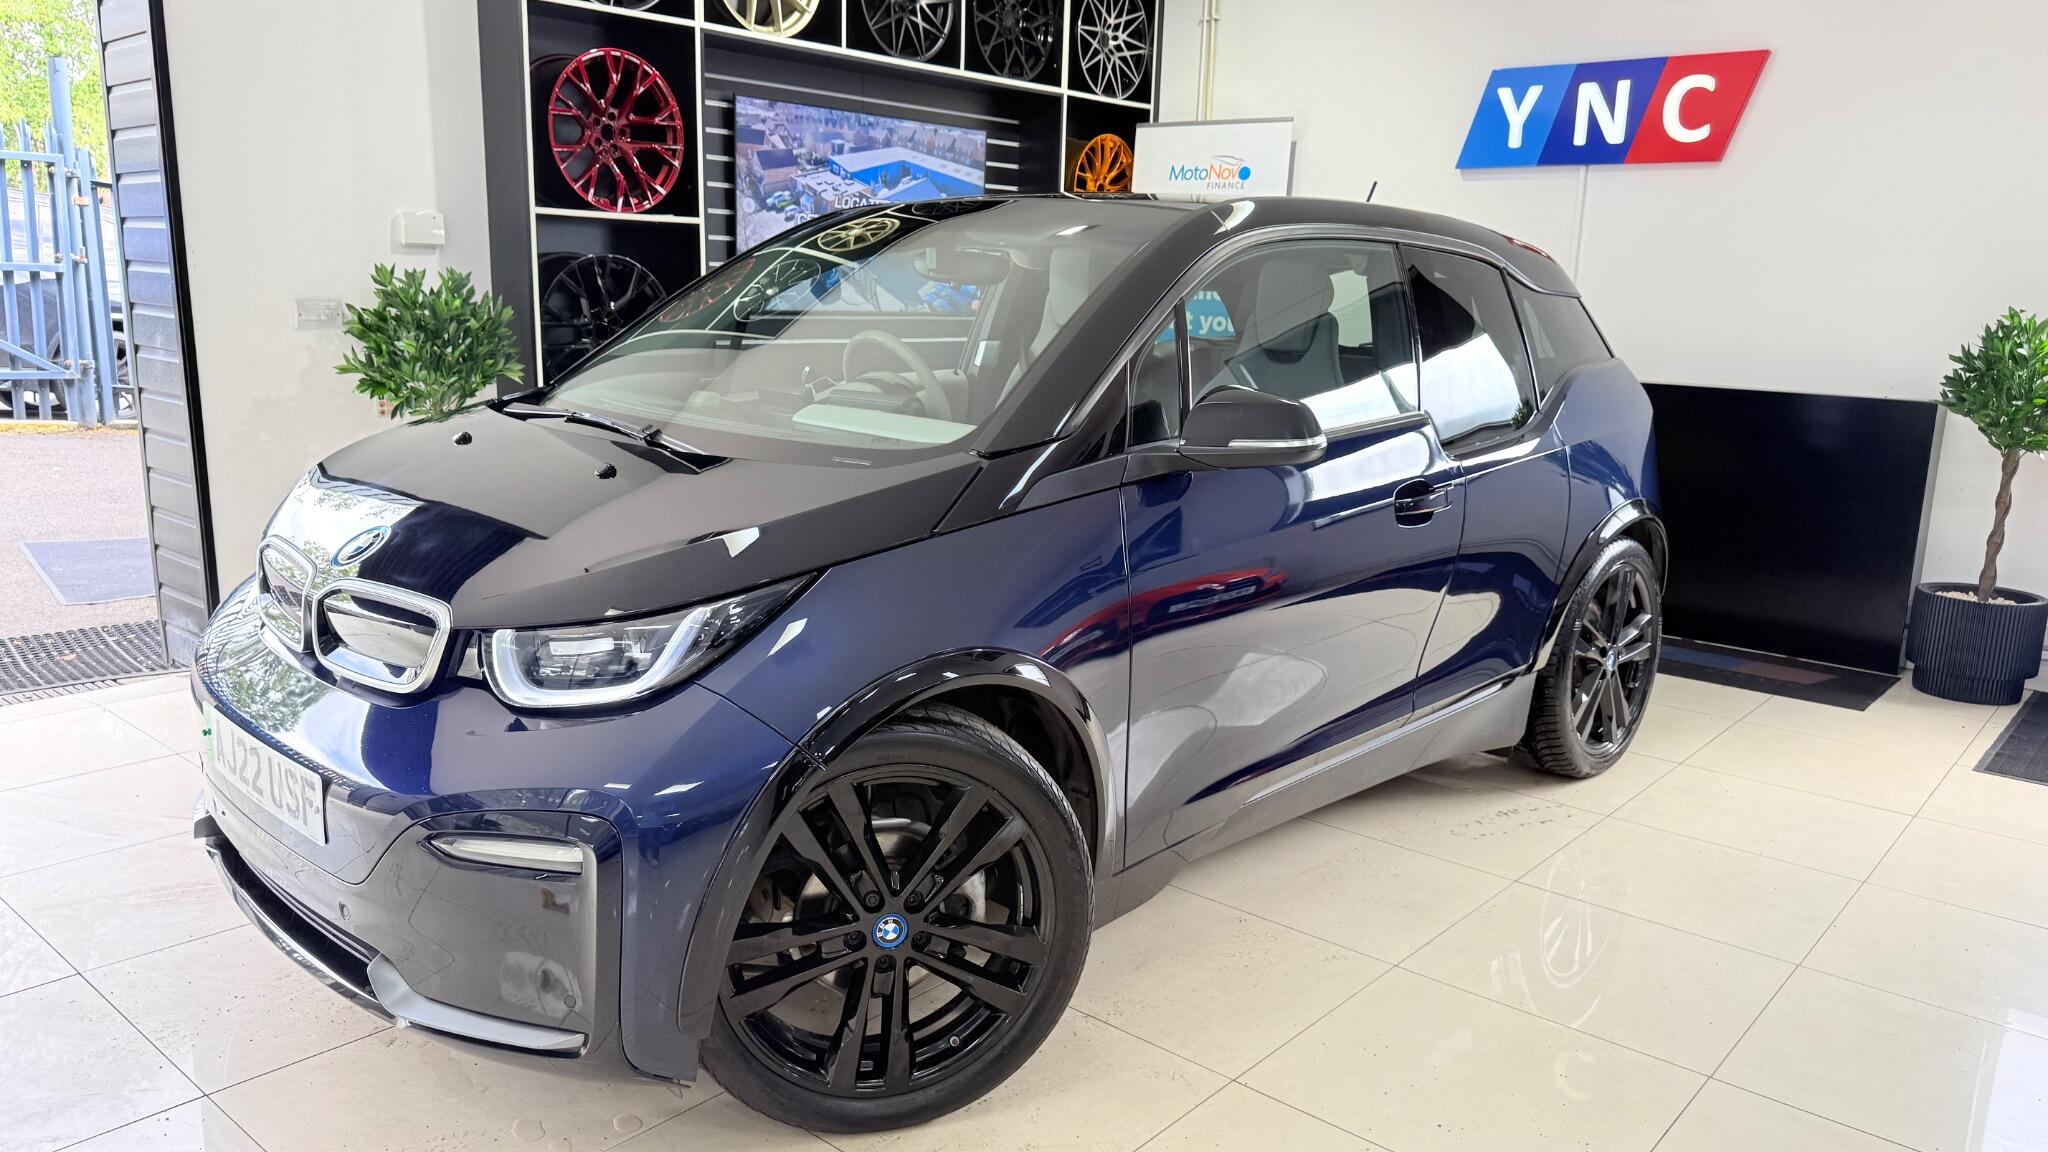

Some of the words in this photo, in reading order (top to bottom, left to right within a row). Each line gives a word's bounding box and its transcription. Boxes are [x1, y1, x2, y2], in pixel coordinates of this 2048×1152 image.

[1497, 74, 1716, 149] YNC
[1207, 181, 1246, 190] FINANCE
[214, 718, 266, 797] AJ22
[268, 756, 317, 826] USF
